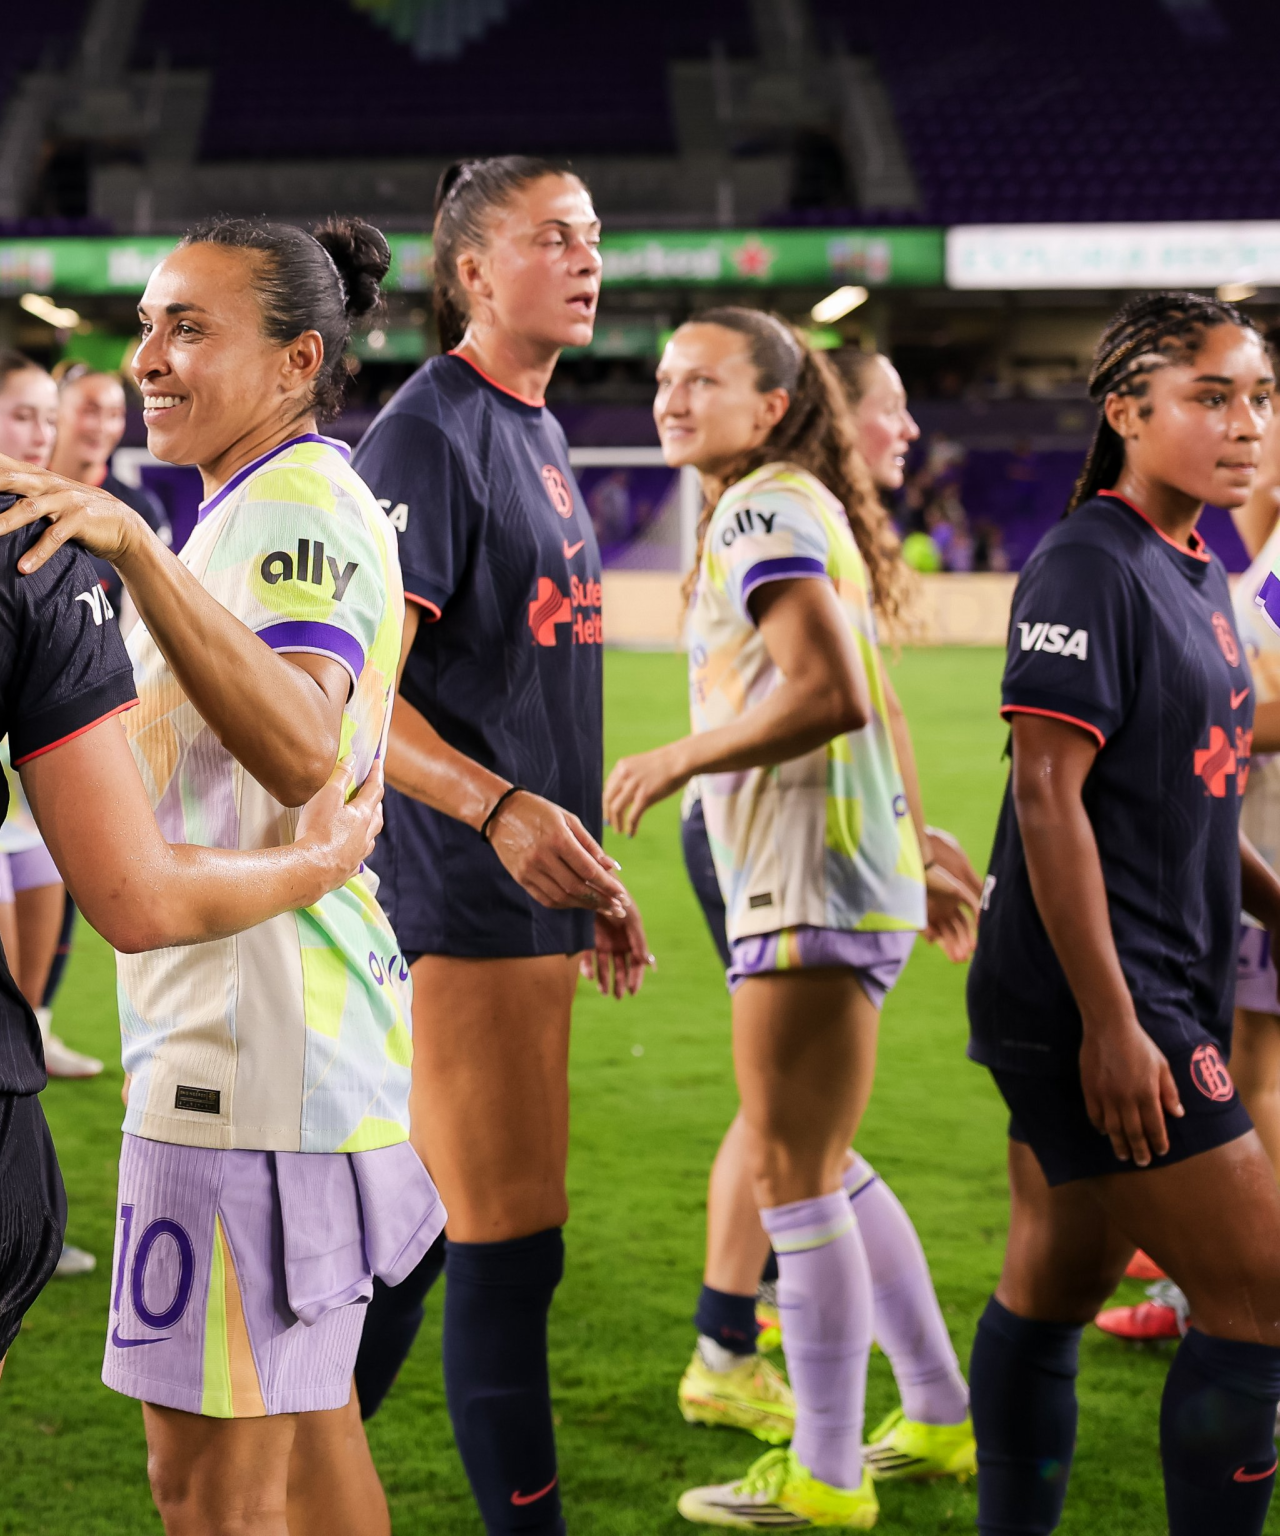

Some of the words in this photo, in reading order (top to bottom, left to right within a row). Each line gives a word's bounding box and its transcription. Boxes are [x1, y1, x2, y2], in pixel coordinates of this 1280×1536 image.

[260, 537, 359, 603] ally
[1016, 620, 1089, 662] VISA
[113, 1202, 196, 1331] 10
